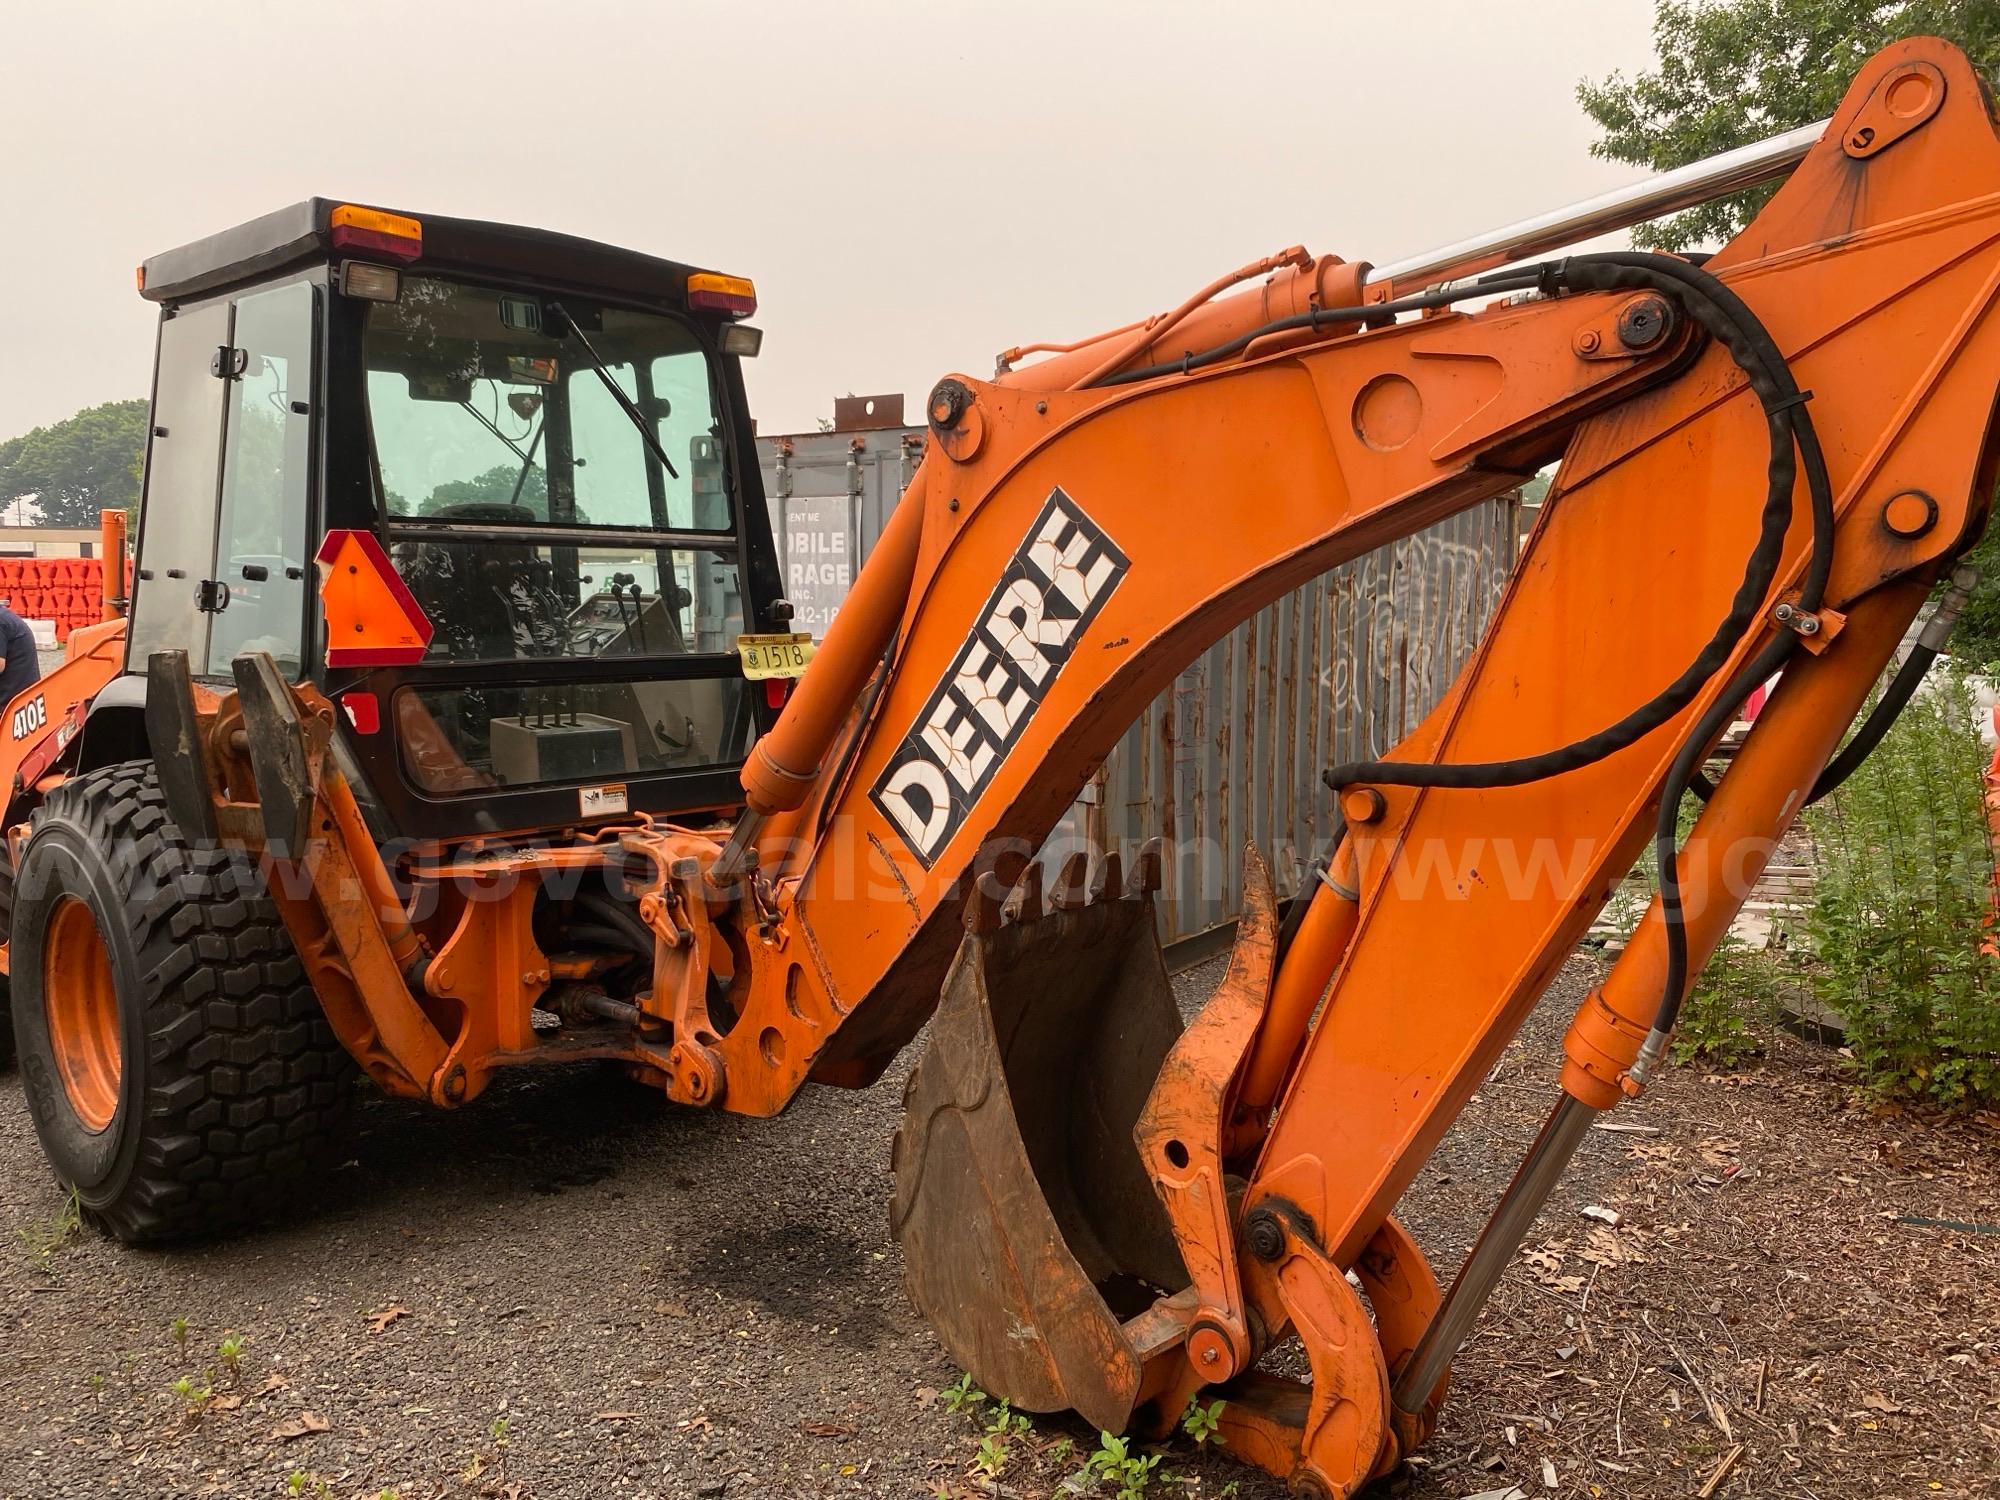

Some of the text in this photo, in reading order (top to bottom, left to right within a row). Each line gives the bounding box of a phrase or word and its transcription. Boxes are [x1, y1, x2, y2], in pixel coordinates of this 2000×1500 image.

[787, 512, 820, 522] ENT ME
[790, 563, 849, 585] RAGE
[791, 589, 814, 600] INC.
[793, 605, 839, 624] 42-18
[762, 645, 804, 669] 1518
[878, 505, 1118, 859] DEERE
[13, 695, 47, 741] 410E
